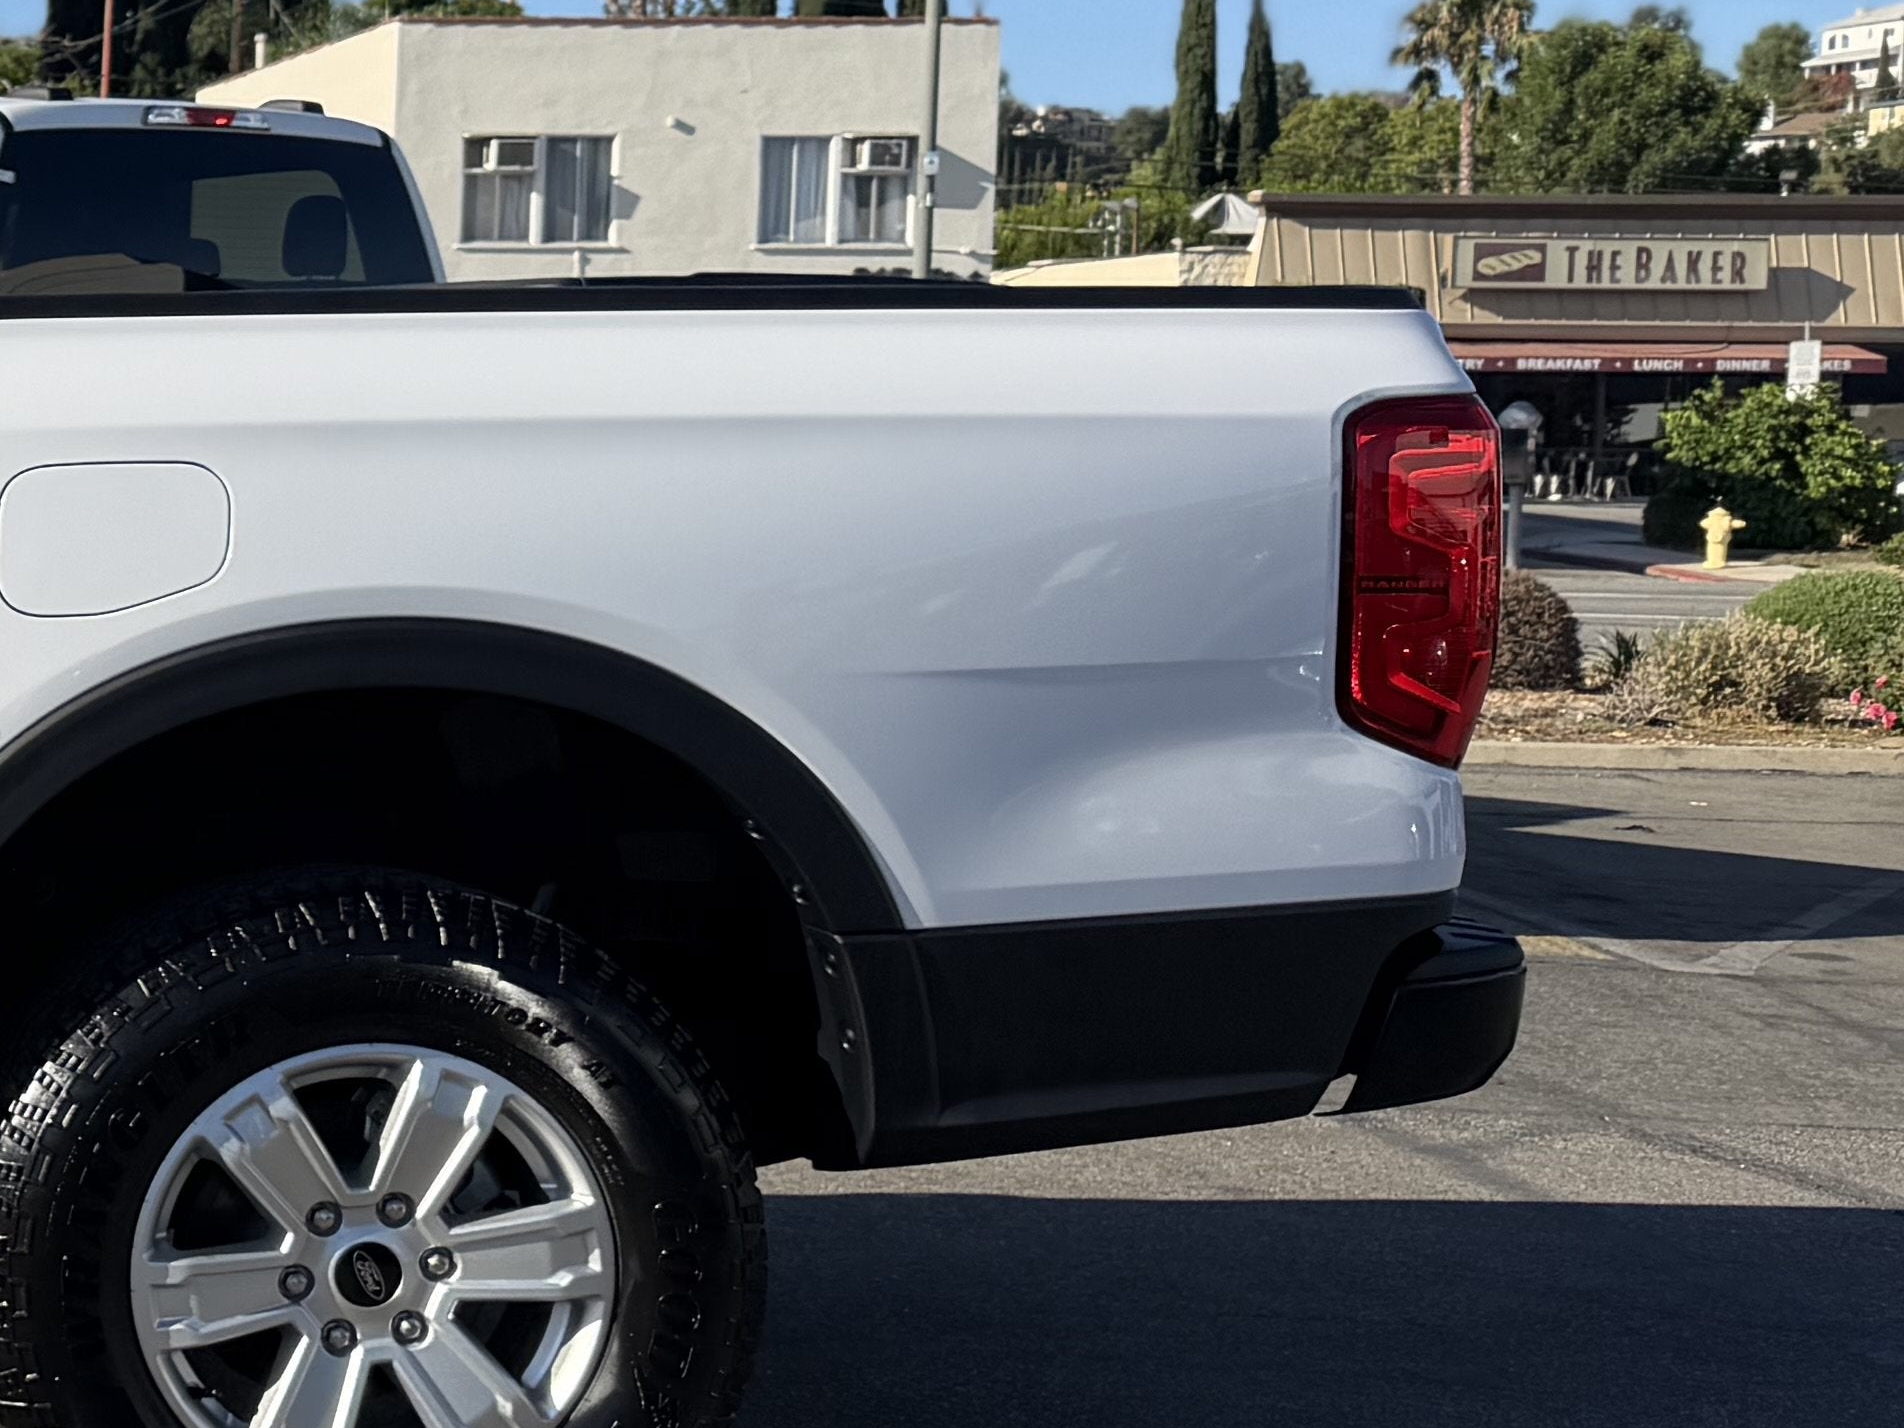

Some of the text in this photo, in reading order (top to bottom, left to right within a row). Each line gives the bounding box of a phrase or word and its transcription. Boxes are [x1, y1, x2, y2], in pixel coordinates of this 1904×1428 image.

[1564, 245, 1747, 285] THE BAKER
[1516, 358, 1602, 371] BREAKFAST
[1633, 358, 1684, 371] LUNCH
[1715, 358, 1772, 372] DINNER
